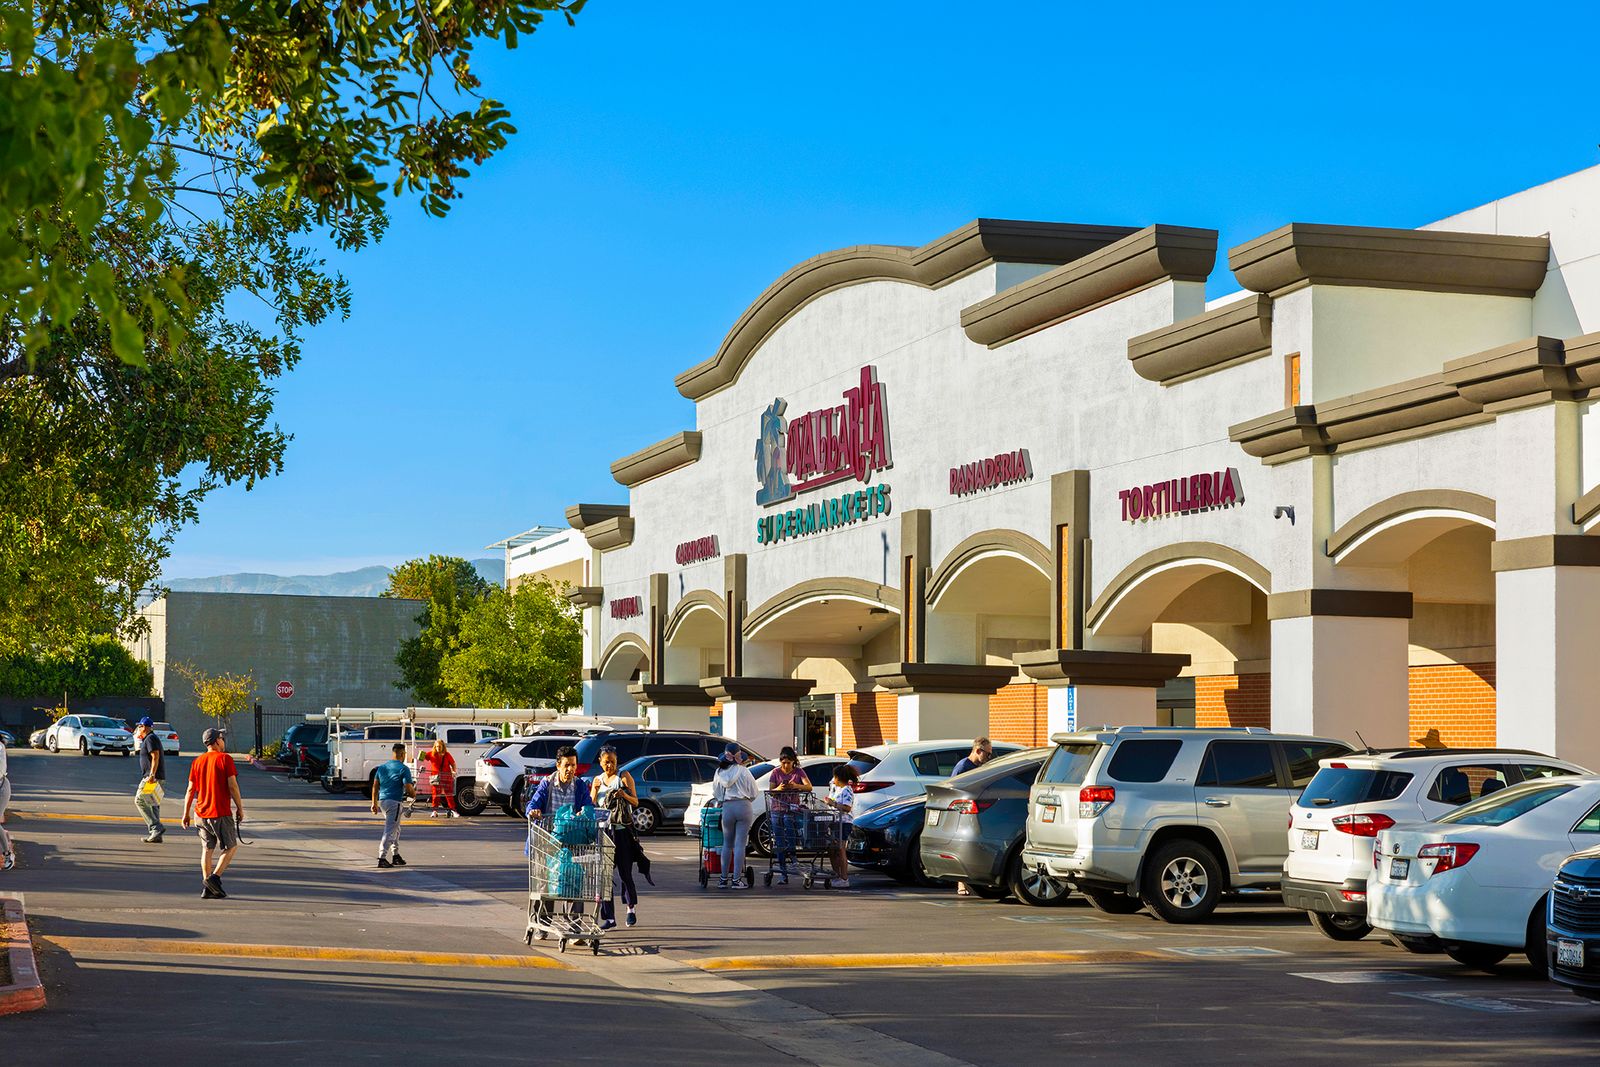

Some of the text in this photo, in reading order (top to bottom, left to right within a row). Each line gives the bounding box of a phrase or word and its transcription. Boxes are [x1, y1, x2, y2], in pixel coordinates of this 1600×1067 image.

[949, 448, 1030, 495] PANADERIA
[1119, 467, 1242, 523] TORTILLERIA
[757, 483, 889, 544] SUPERMARKETS
[277, 686, 293, 694] STOP
